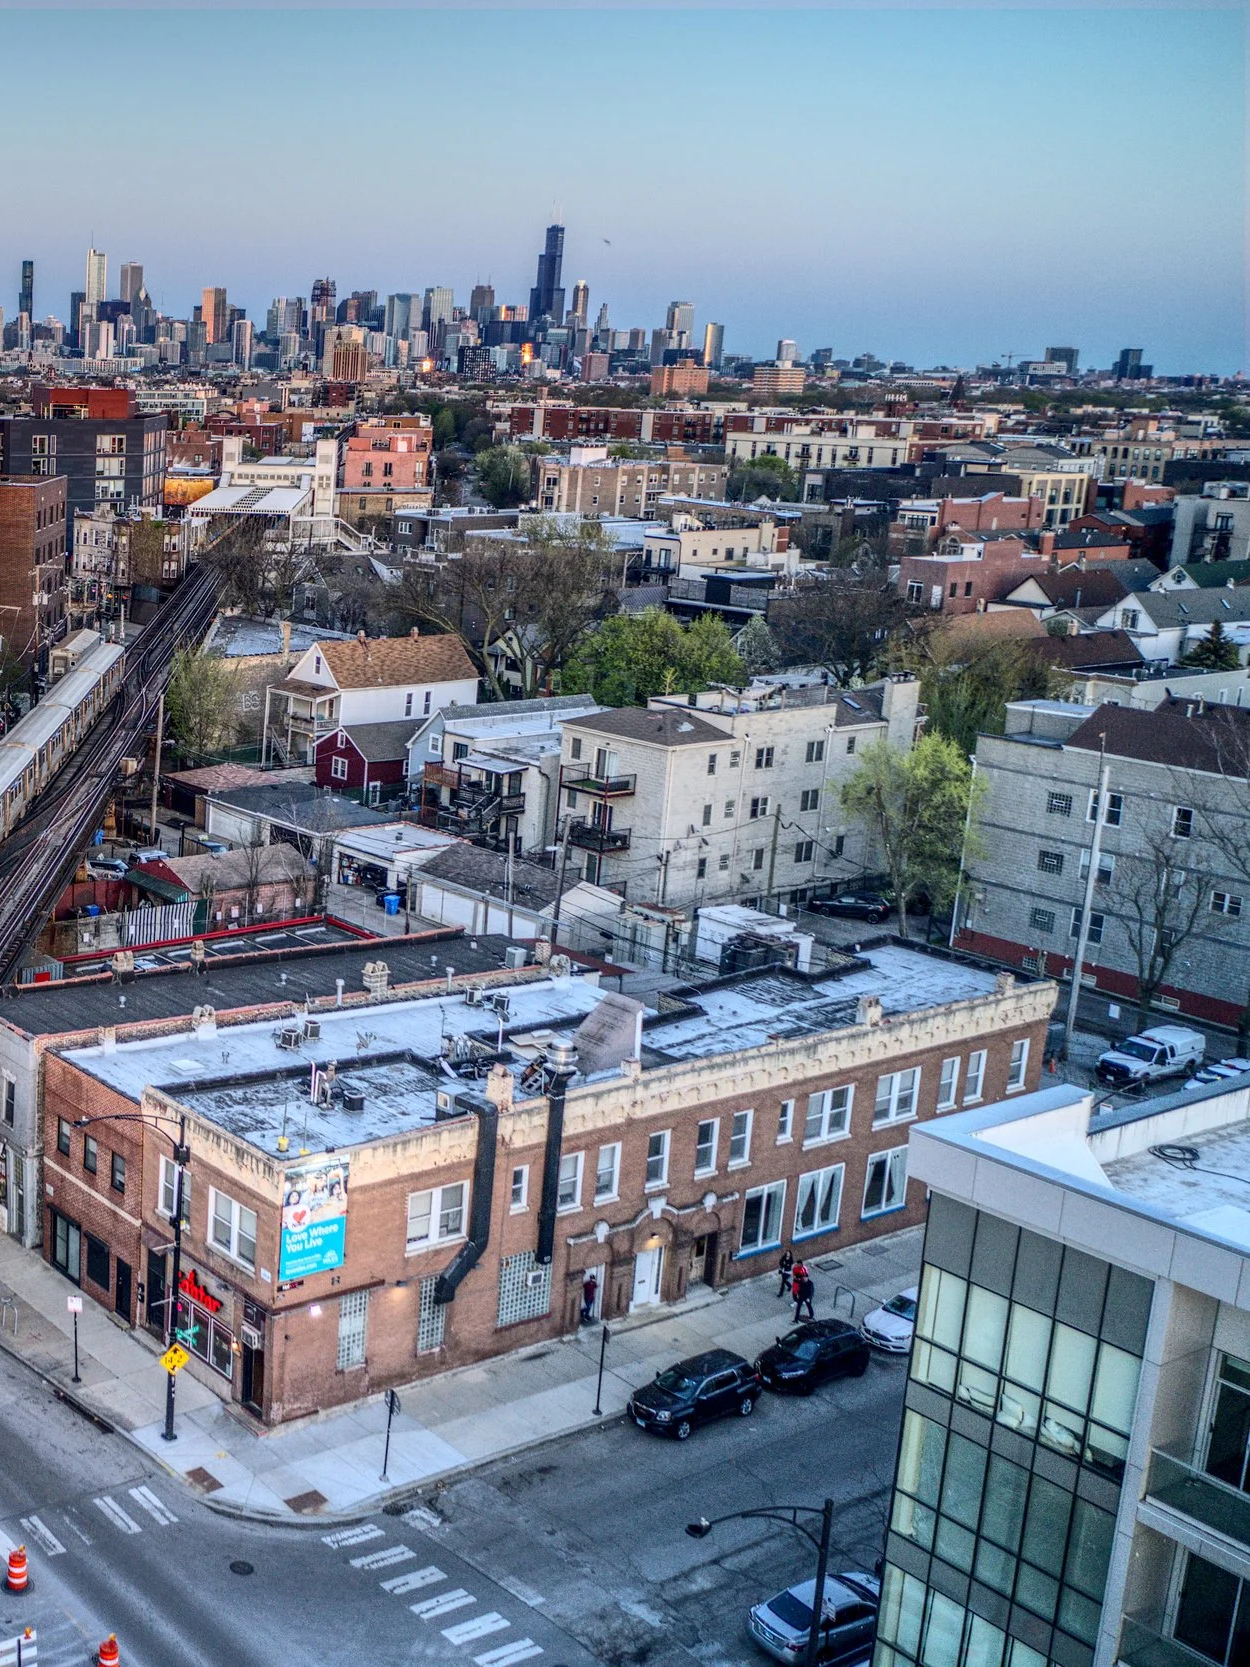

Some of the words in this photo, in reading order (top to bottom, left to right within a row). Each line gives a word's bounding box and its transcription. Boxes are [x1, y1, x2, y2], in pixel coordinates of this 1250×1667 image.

[286, 1231, 308, 1245] Love
[309, 1223, 339, 1237] Where
[286, 1241, 303, 1255] You
[305, 1237, 323, 1250] Live
